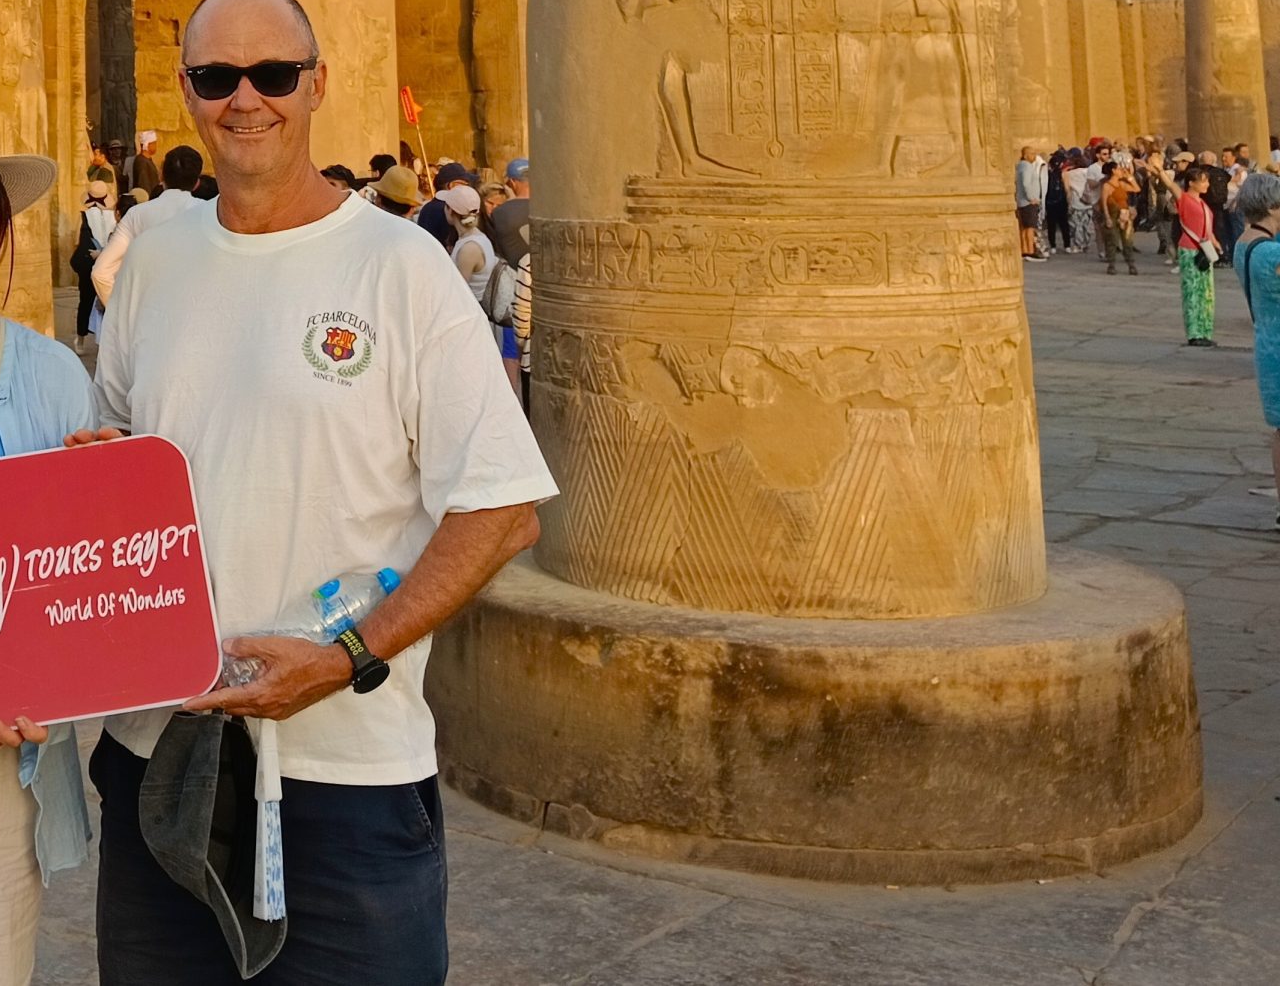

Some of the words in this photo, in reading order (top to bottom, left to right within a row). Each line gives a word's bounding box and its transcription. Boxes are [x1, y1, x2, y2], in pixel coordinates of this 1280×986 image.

[306, 314, 321, 328] FC
[321, 310, 377, 345] BARCELONA
[313, 371, 335, 383] SINCE
[24, 539, 105, 582] TOURS
[111, 524, 197, 578] EGYPT
[45, 595, 94, 626] World
[97, 591, 115, 617] Of
[118, 585, 186, 614] Wonders
